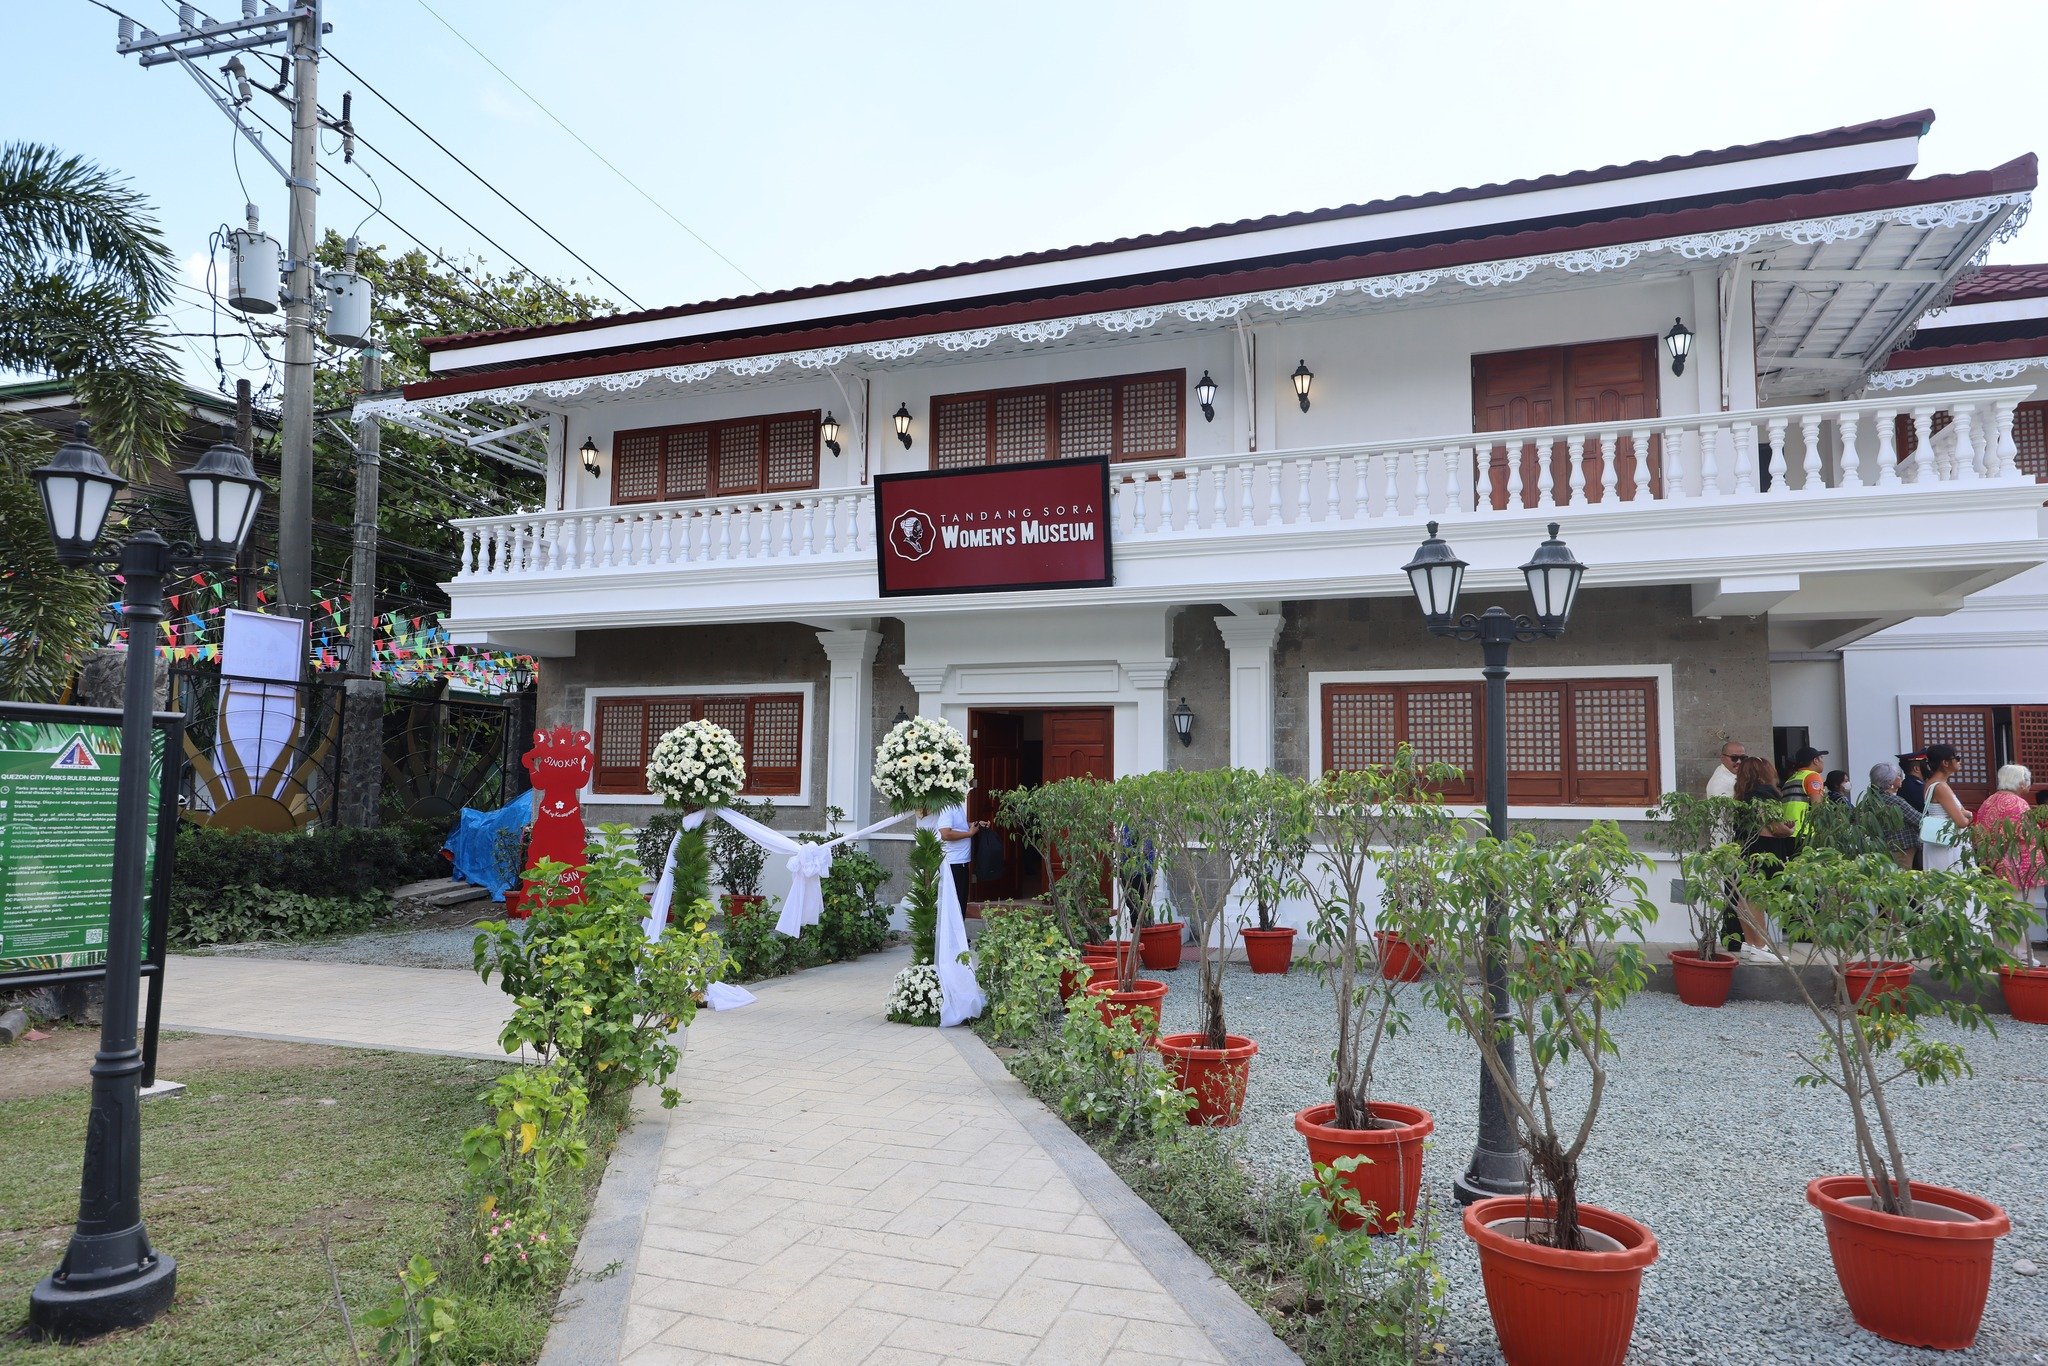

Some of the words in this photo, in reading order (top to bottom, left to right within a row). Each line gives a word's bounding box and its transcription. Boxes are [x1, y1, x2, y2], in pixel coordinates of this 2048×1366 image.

[940, 508, 1032, 523] TANDANG
[1043, 504, 1093, 516] SORA
[1021, 520, 1094, 545] MUSEUM
[544, 756, 564, 768] SINO
[564, 757, 579, 768] KA?
